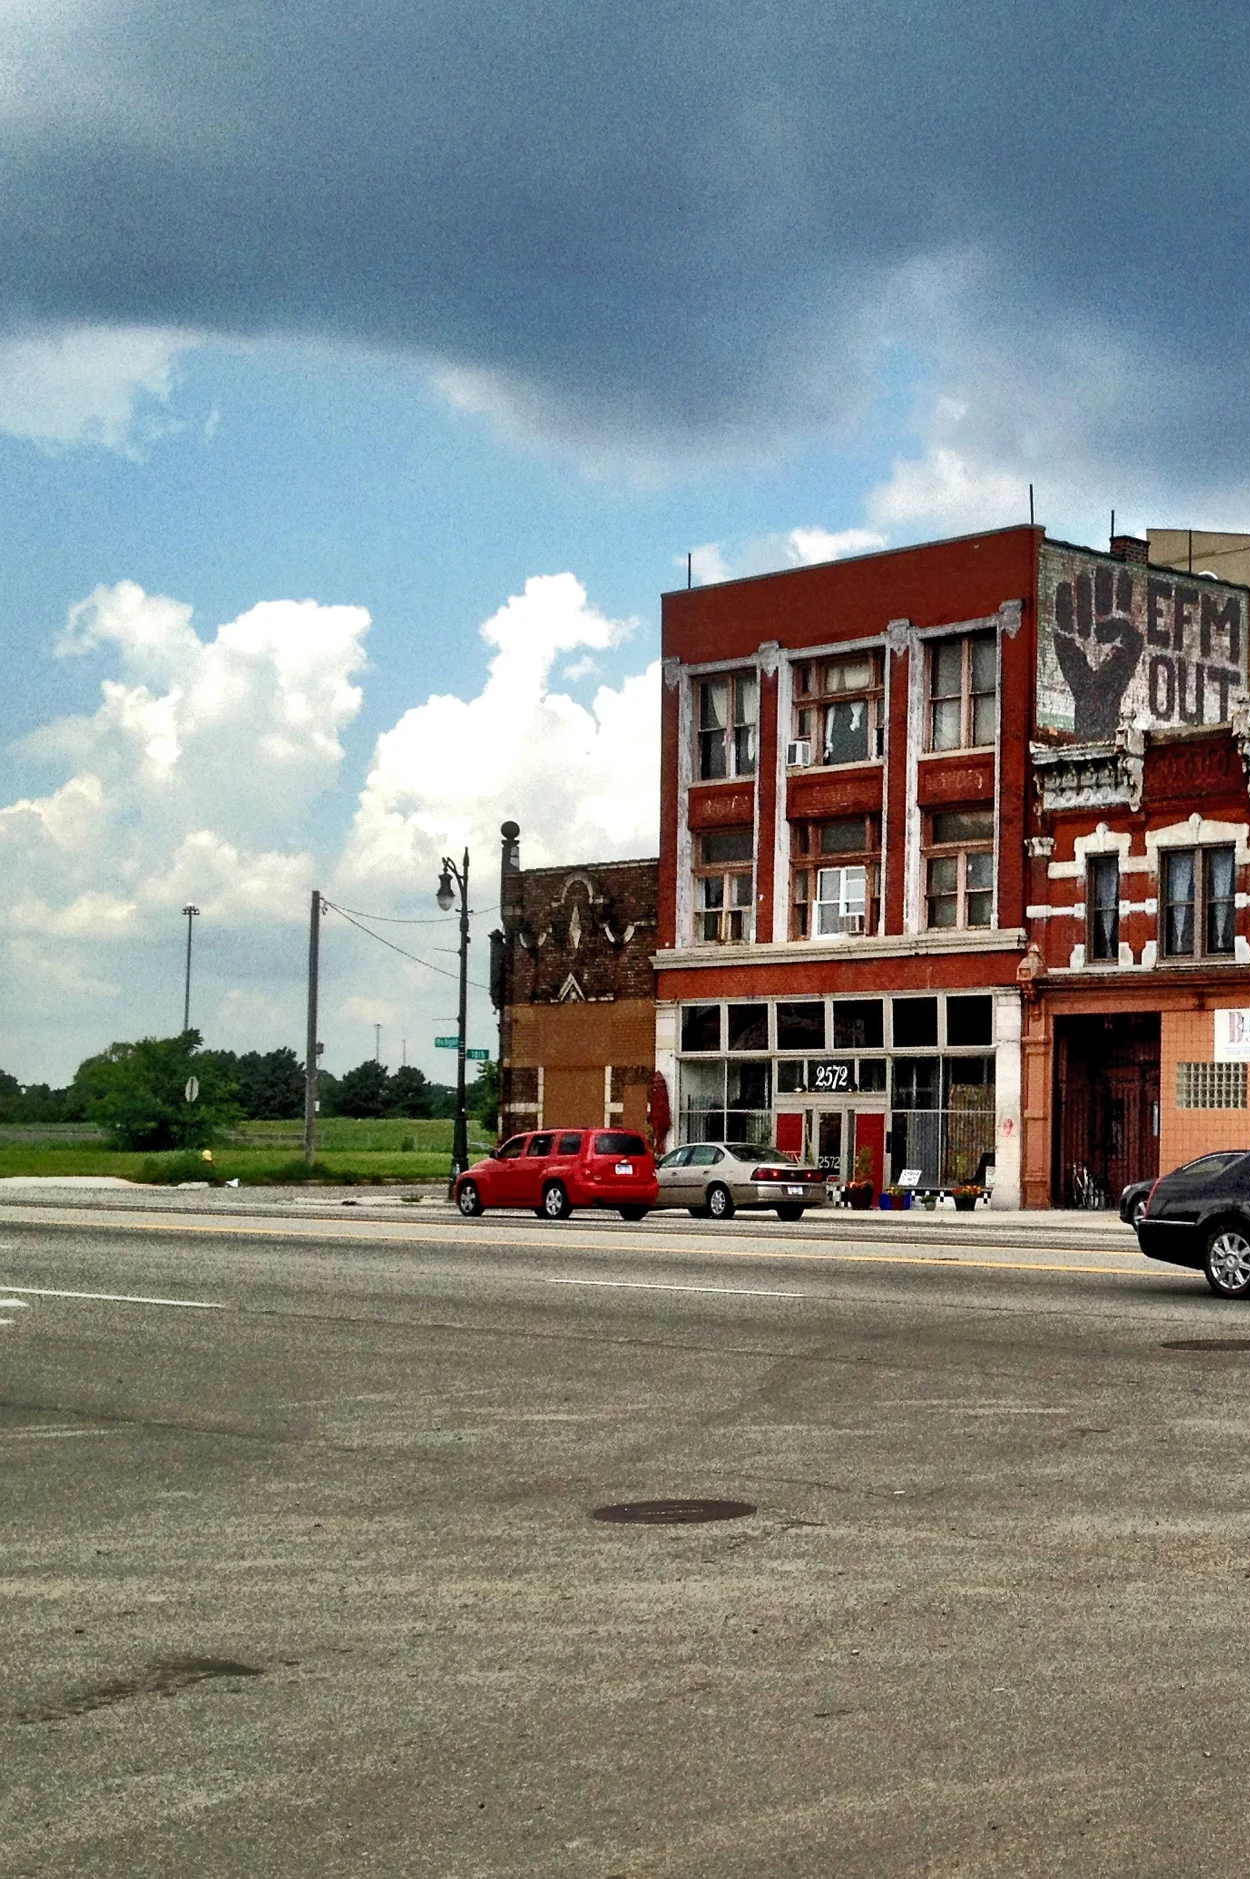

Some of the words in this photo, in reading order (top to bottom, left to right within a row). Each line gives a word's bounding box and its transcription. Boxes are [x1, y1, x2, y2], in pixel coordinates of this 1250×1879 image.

[1150, 654, 1241, 725] OUT
[816, 1065, 848, 1089] 2572
[818, 1157, 840, 1169] 2572
